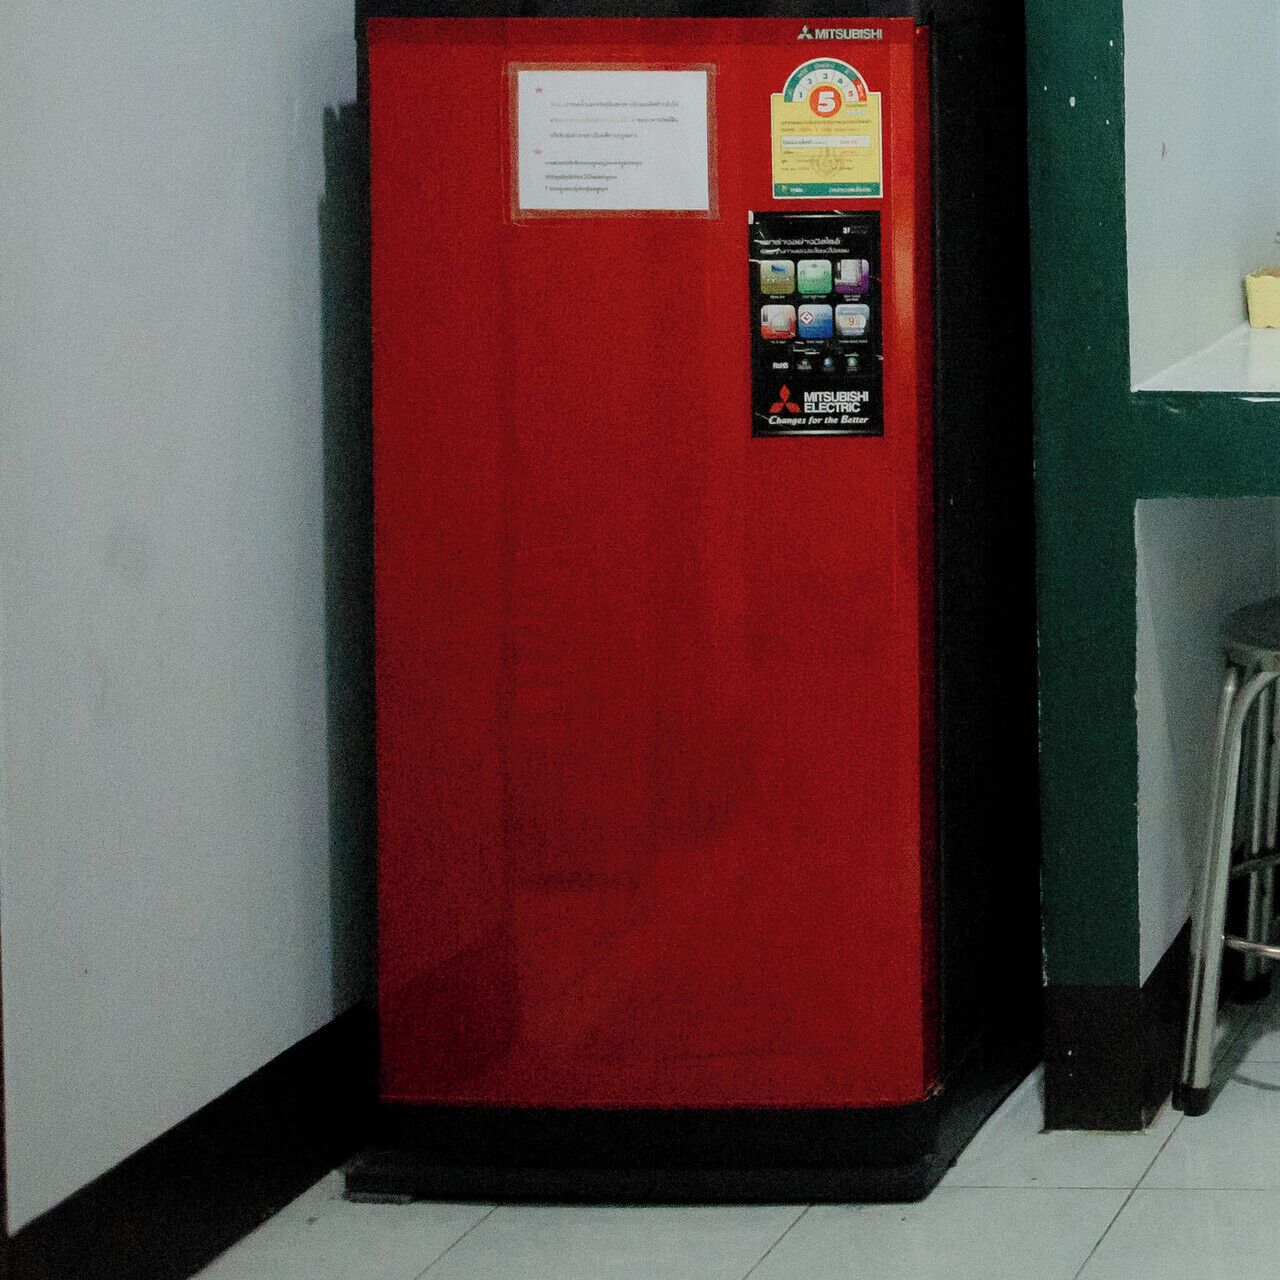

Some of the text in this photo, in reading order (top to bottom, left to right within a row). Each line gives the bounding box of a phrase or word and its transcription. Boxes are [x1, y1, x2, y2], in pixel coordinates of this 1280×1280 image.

[815, 28, 883, 40] MITSUBISHI
[817, 91, 836, 113] 5
[804, 391, 869, 402] MITSUBISHI
[804, 402, 861, 413] ELECTRIC
[768, 415, 869, 425] Changes for the Better
